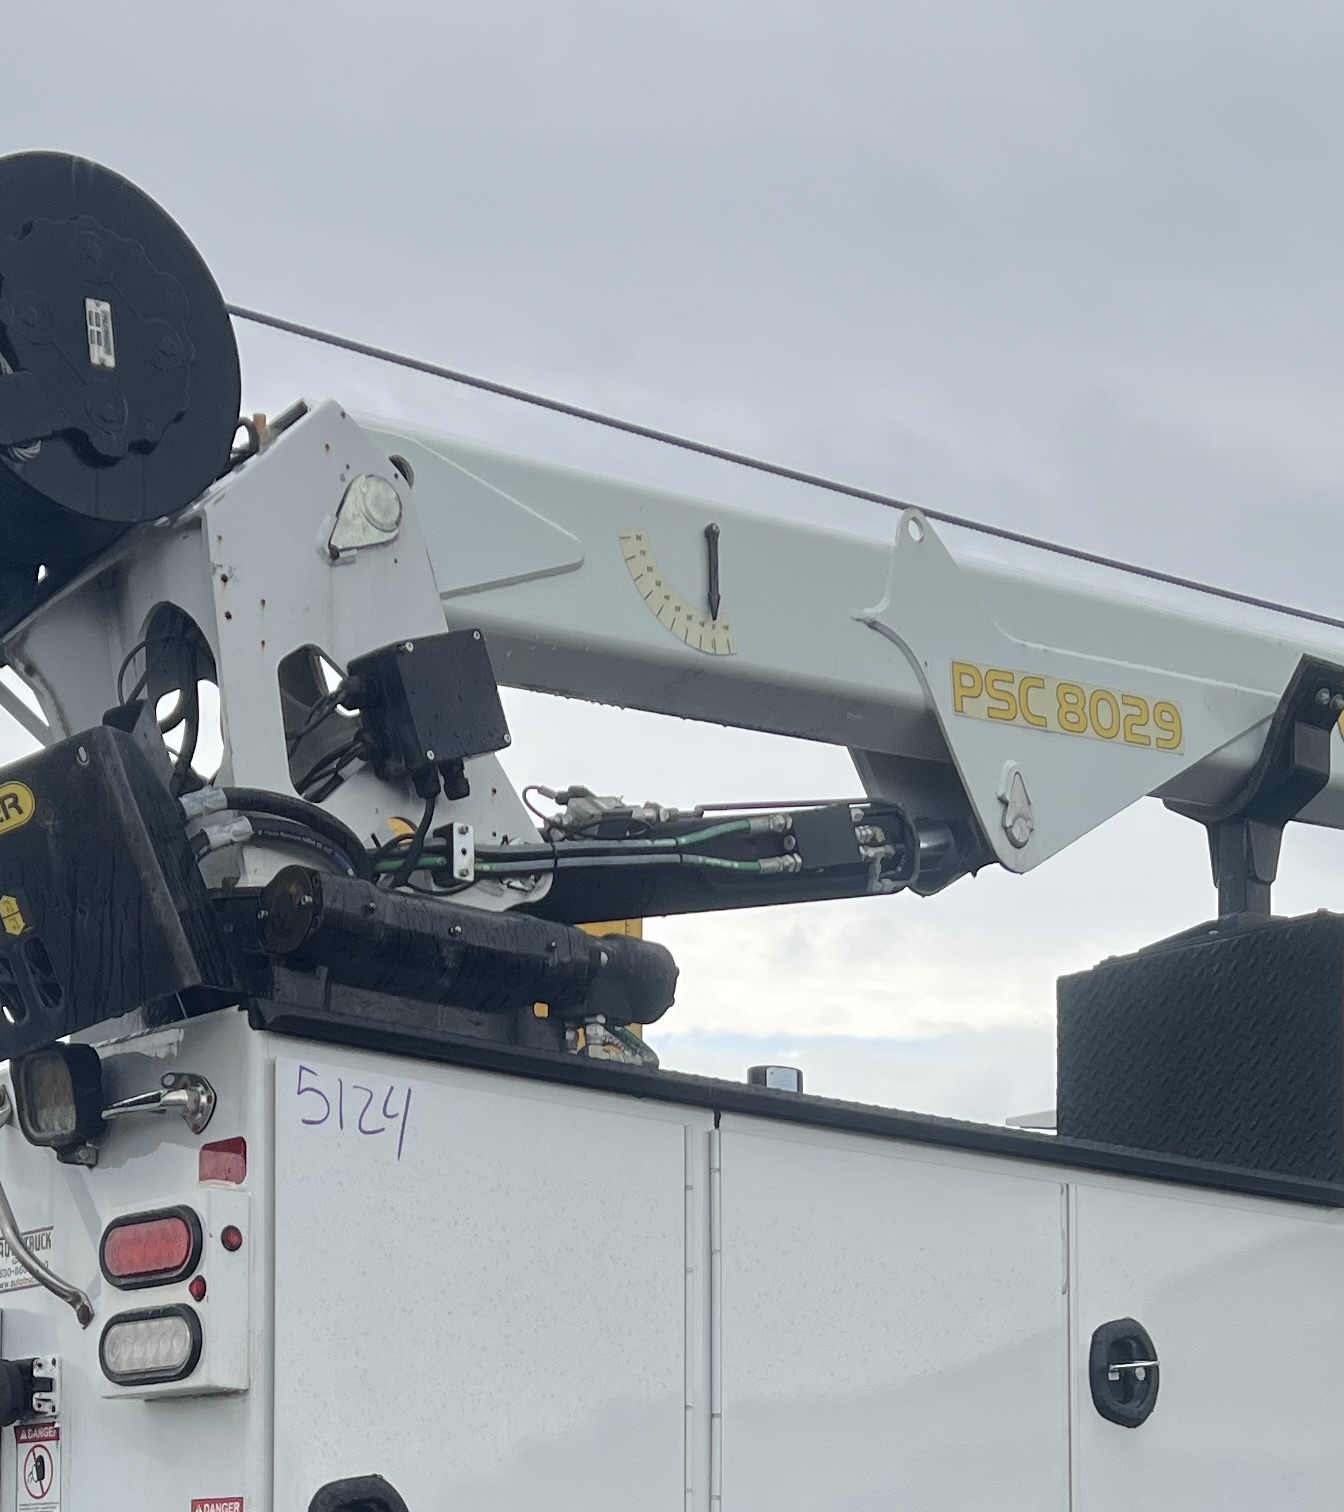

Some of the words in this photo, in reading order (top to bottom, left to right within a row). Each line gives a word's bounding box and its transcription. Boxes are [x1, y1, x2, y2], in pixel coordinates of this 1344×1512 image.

[952, 659, 1046, 728] PSC
[1057, 682, 1183, 752] 8029
[296, 1065, 411, 1160] 5124
